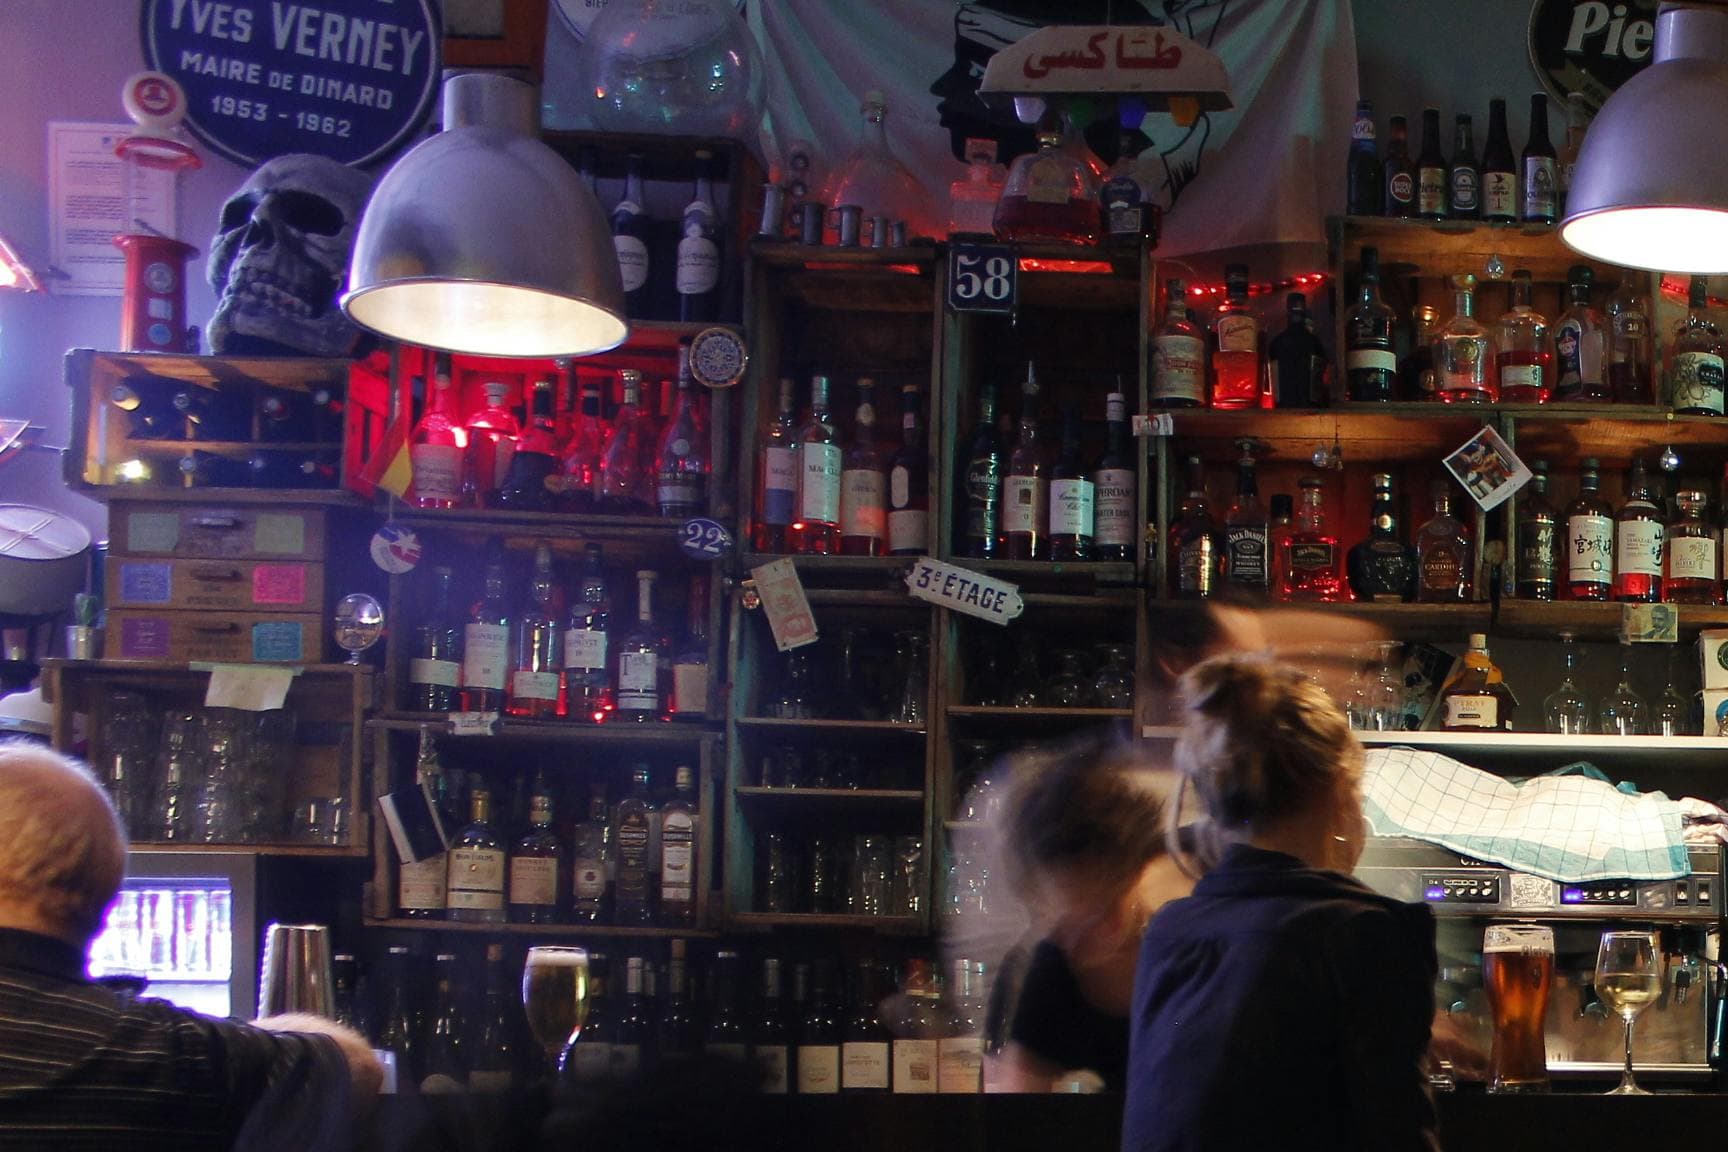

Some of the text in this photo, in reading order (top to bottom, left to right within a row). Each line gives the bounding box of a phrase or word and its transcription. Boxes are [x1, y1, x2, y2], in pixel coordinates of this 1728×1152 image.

[170, 0, 425, 76] YVES VERNEY
[181, 51, 394, 110] MAIRE DE DINARD
[212, 96, 270, 121] 1953
[297, 111, 352, 138] 1962
[954, 255, 1010, 301] 58
[684, 522, 722, 553] 22
[942, 573, 1008, 613] ÉTAGE
